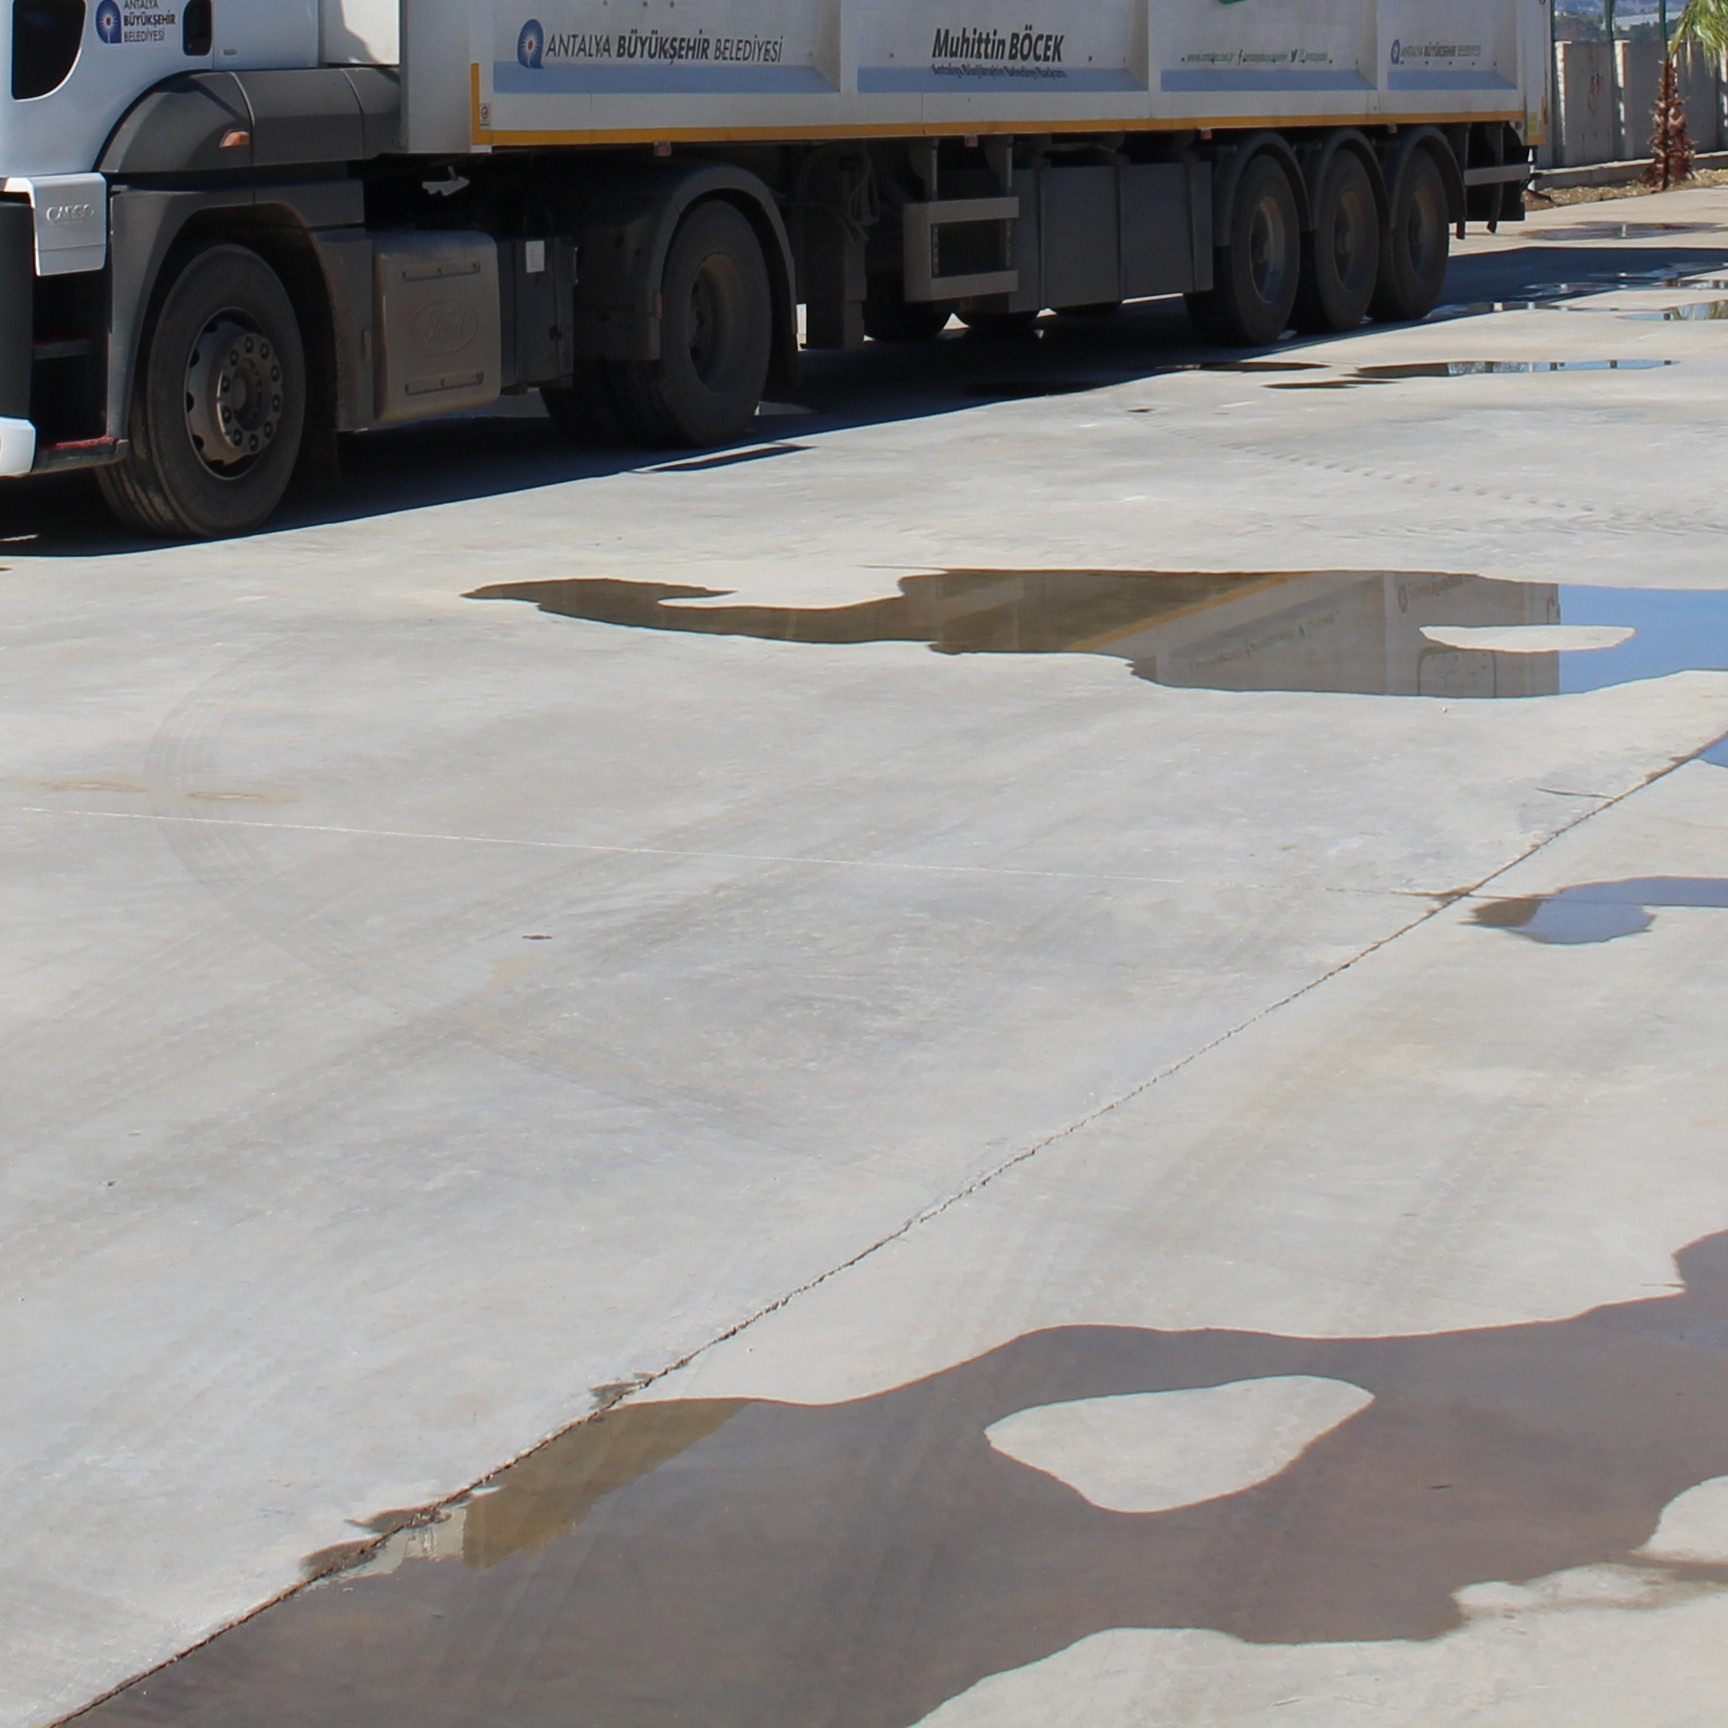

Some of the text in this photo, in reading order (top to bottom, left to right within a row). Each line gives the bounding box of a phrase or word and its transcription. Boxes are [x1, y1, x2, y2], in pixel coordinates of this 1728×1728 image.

[123, 10, 176, 29] BÜYÜKŞEHİR
[123, 27, 165, 44] BELEDİYESİ
[932, 24, 1065, 62] Muhittin BÖCEK
[545, 29, 784, 65] ANTALYA BÜYÜKŞEHİR BELEDİYESİ
[45, 203, 94, 221] CARGO
